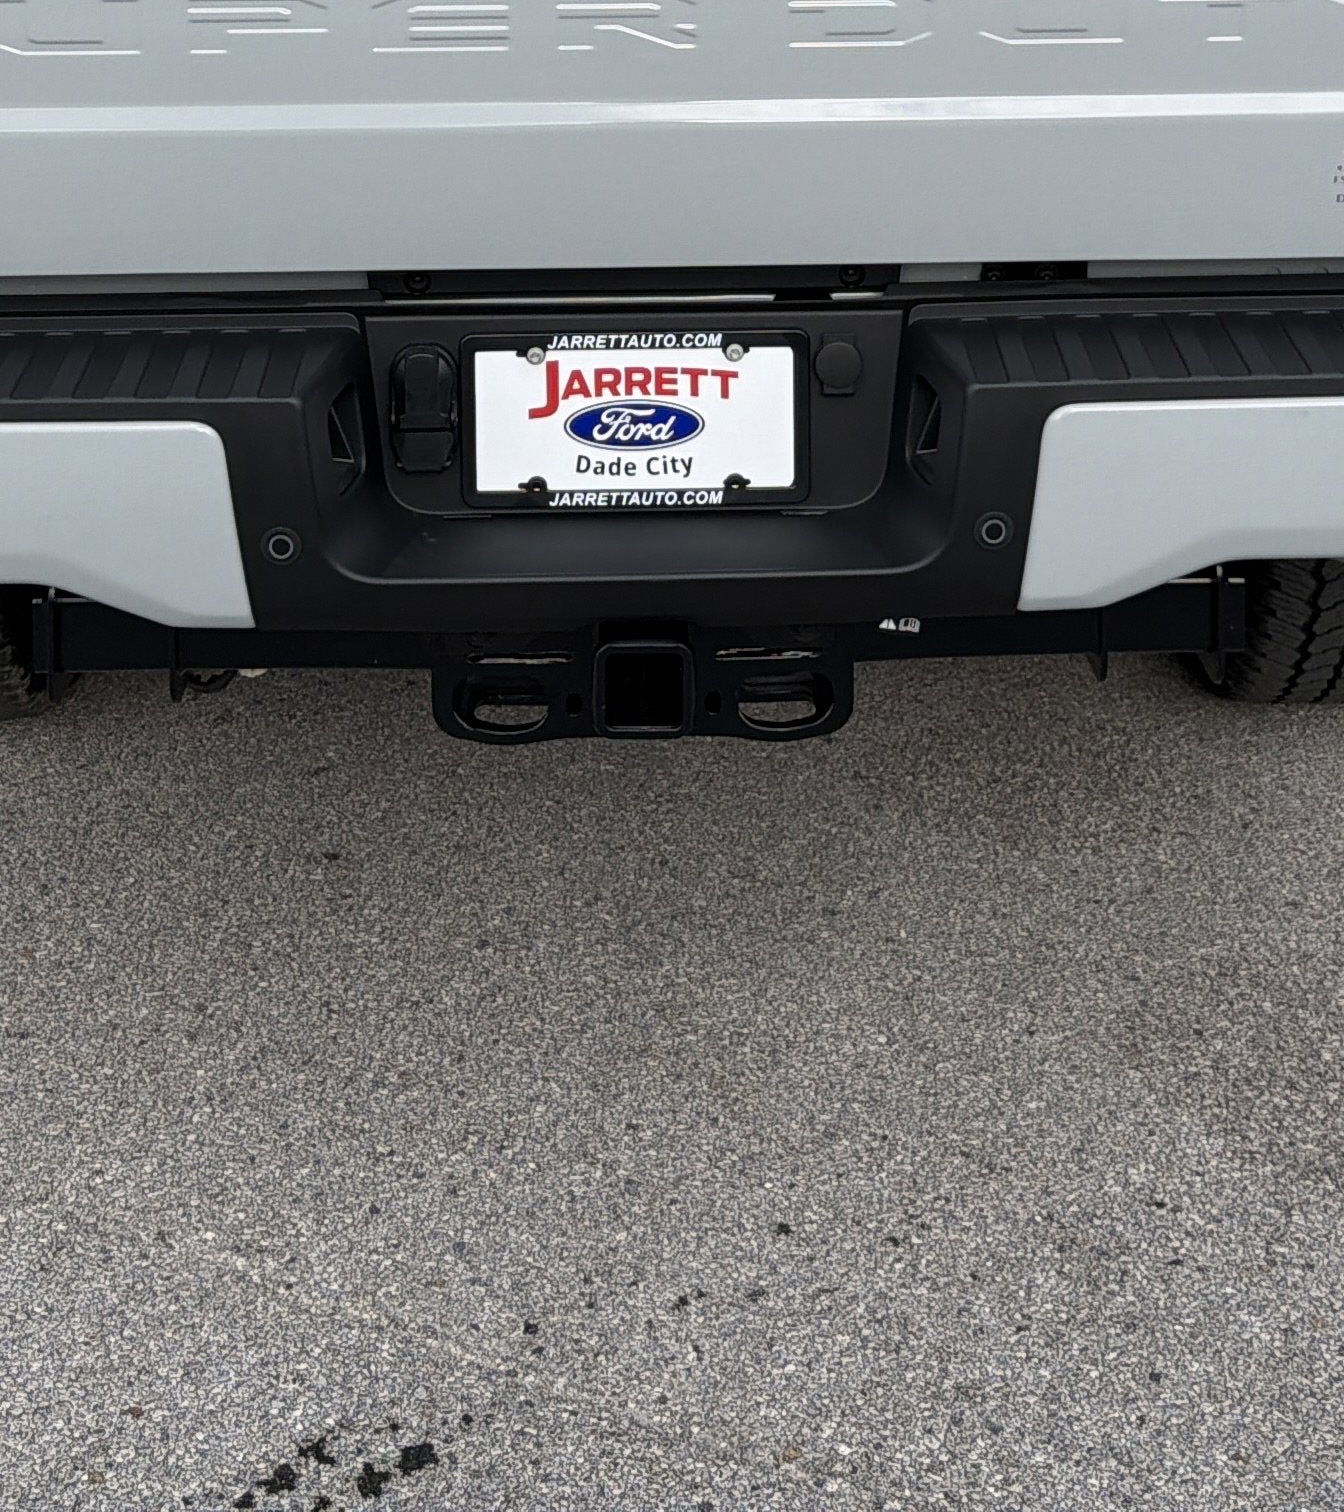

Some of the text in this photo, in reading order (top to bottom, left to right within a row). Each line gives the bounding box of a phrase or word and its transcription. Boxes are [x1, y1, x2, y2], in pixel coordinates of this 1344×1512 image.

[547, 333, 723, 350] JARRETTAUTO.COM
[528, 360, 739, 419] JARRETT
[592, 407, 677, 442] Ford
[575, 455, 693, 479] Dade City
[549, 491, 723, 507] JARRETTAUTO.COM
